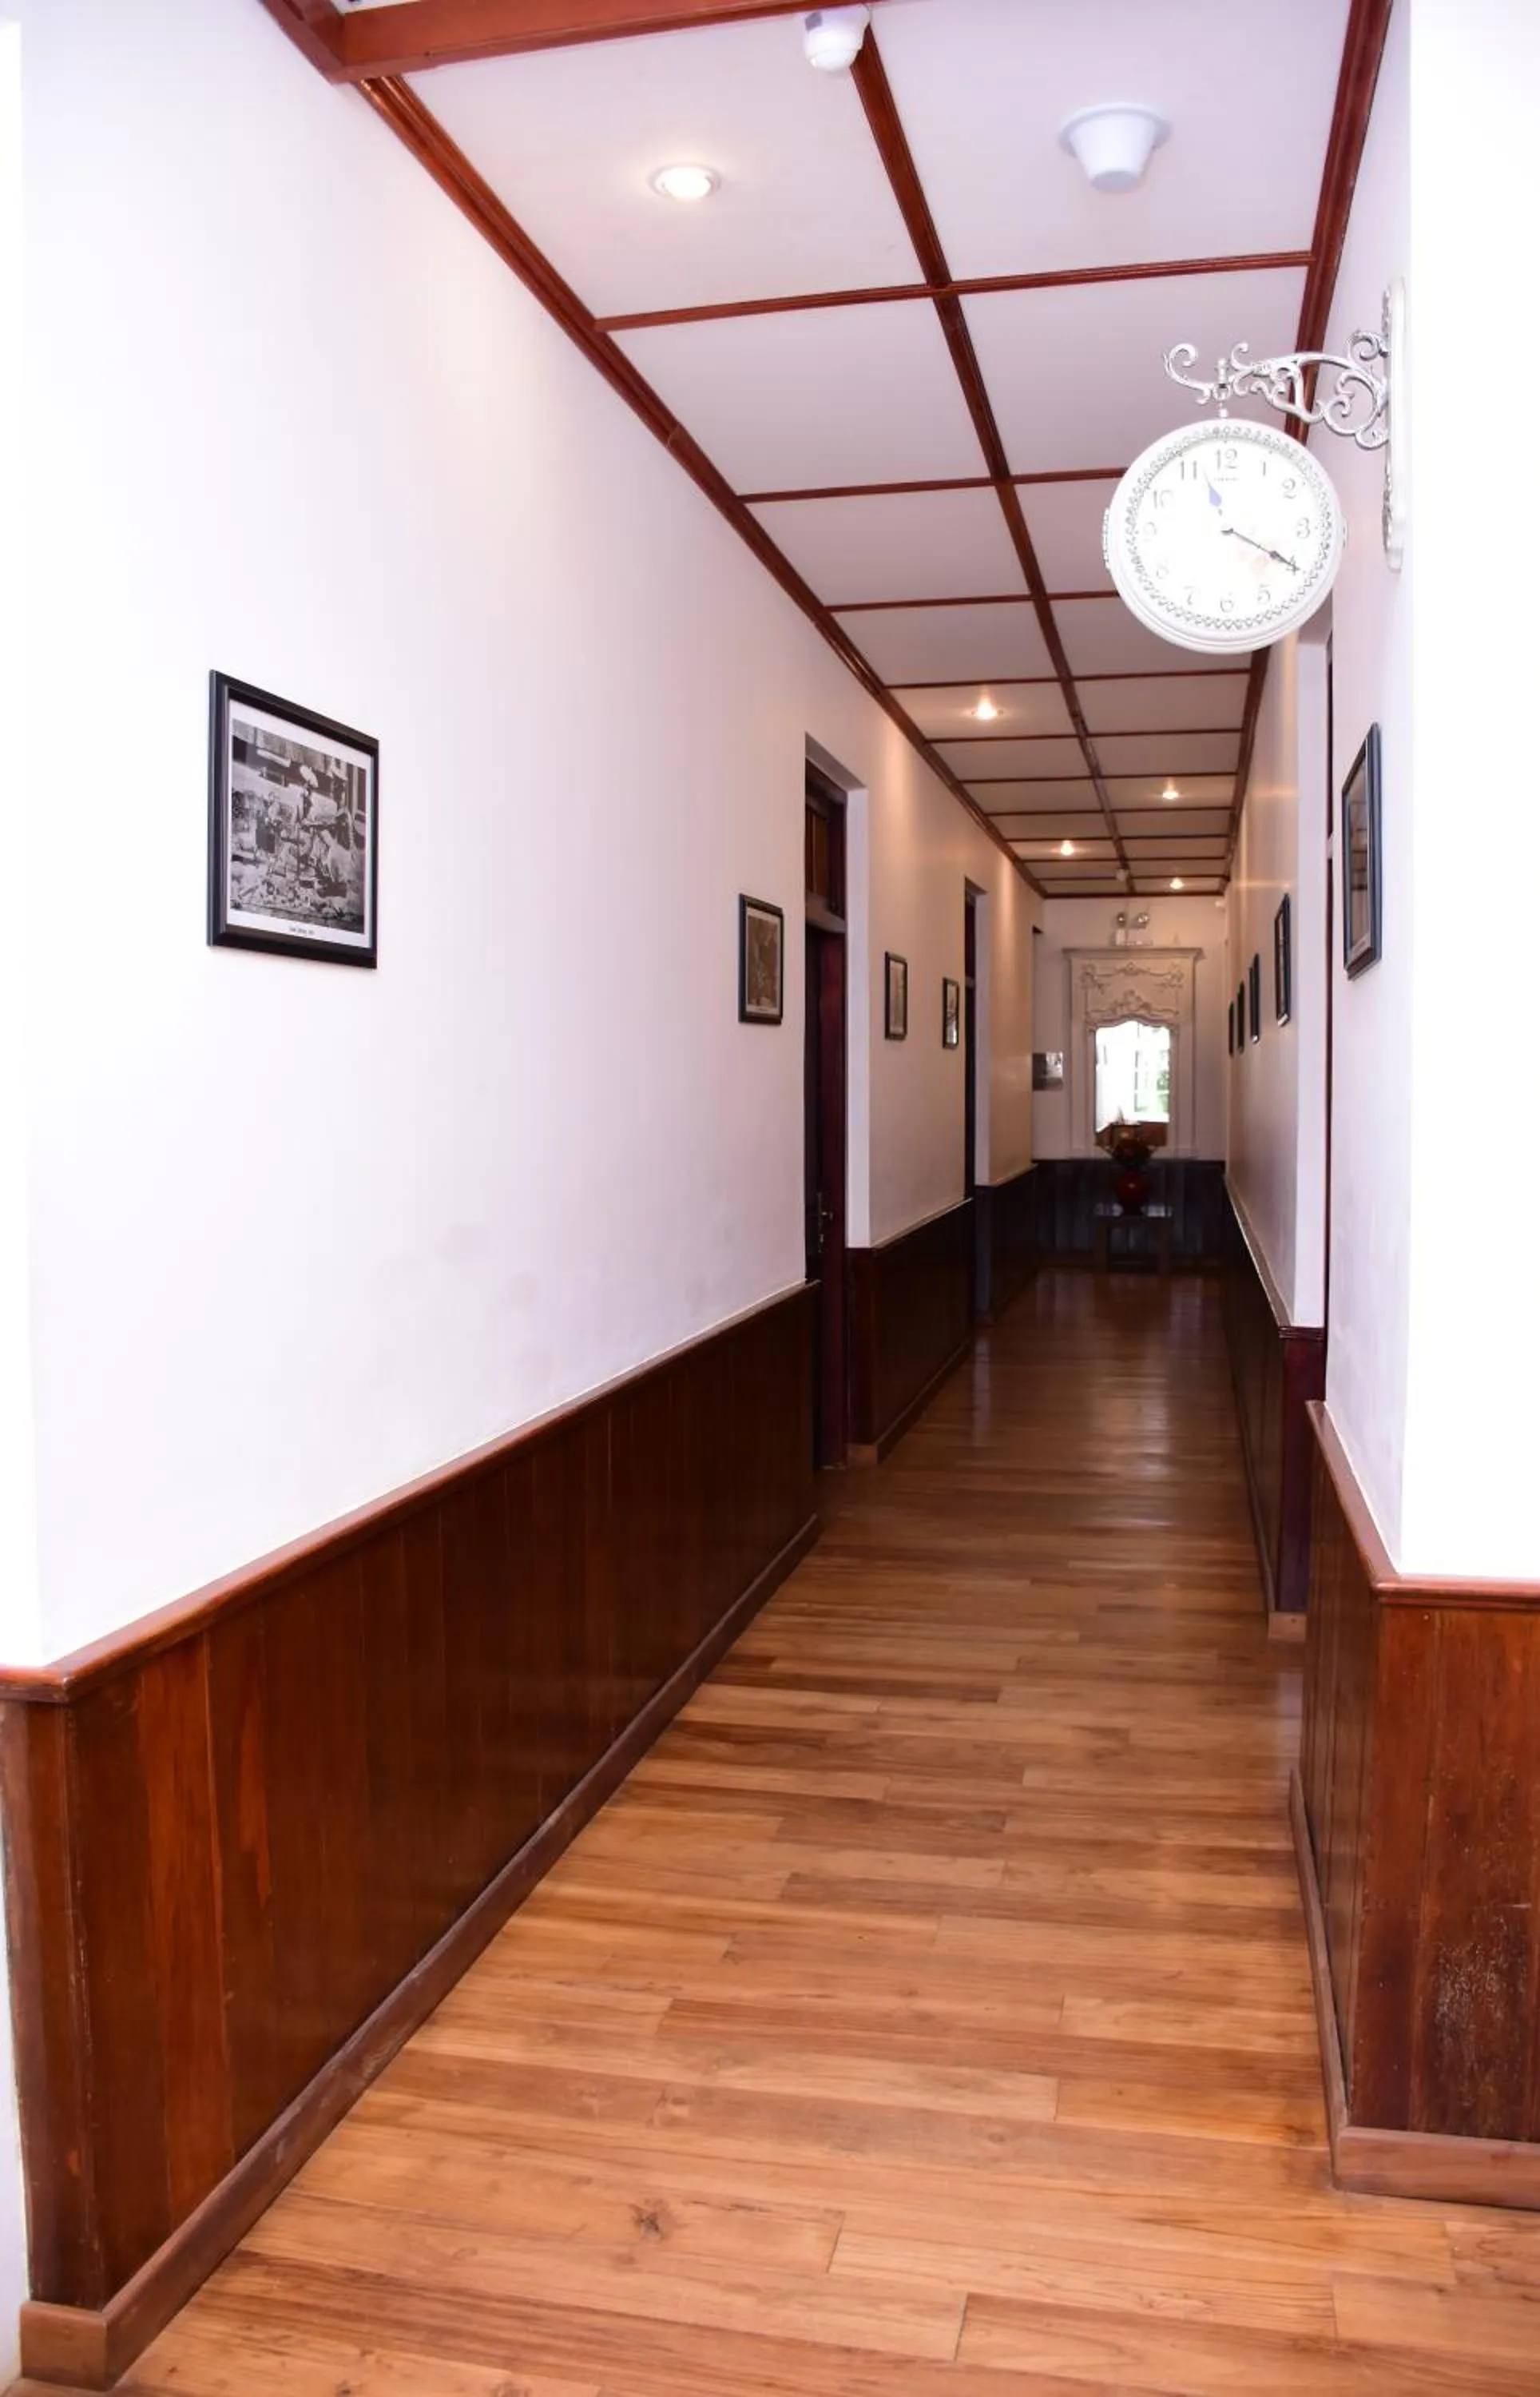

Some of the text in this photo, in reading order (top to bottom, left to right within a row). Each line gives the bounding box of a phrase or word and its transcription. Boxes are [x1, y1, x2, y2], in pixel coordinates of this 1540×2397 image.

[1180, 459, 1198, 481] 11
[1216, 448, 1238, 470] 12
[1282, 477, 1296, 499] 2
[1153, 489, 1174, 510] 10
[1296, 517, 1311, 539] 3
[1220, 592, 1234, 613] 6
[1256, 583, 1272, 605] 5
